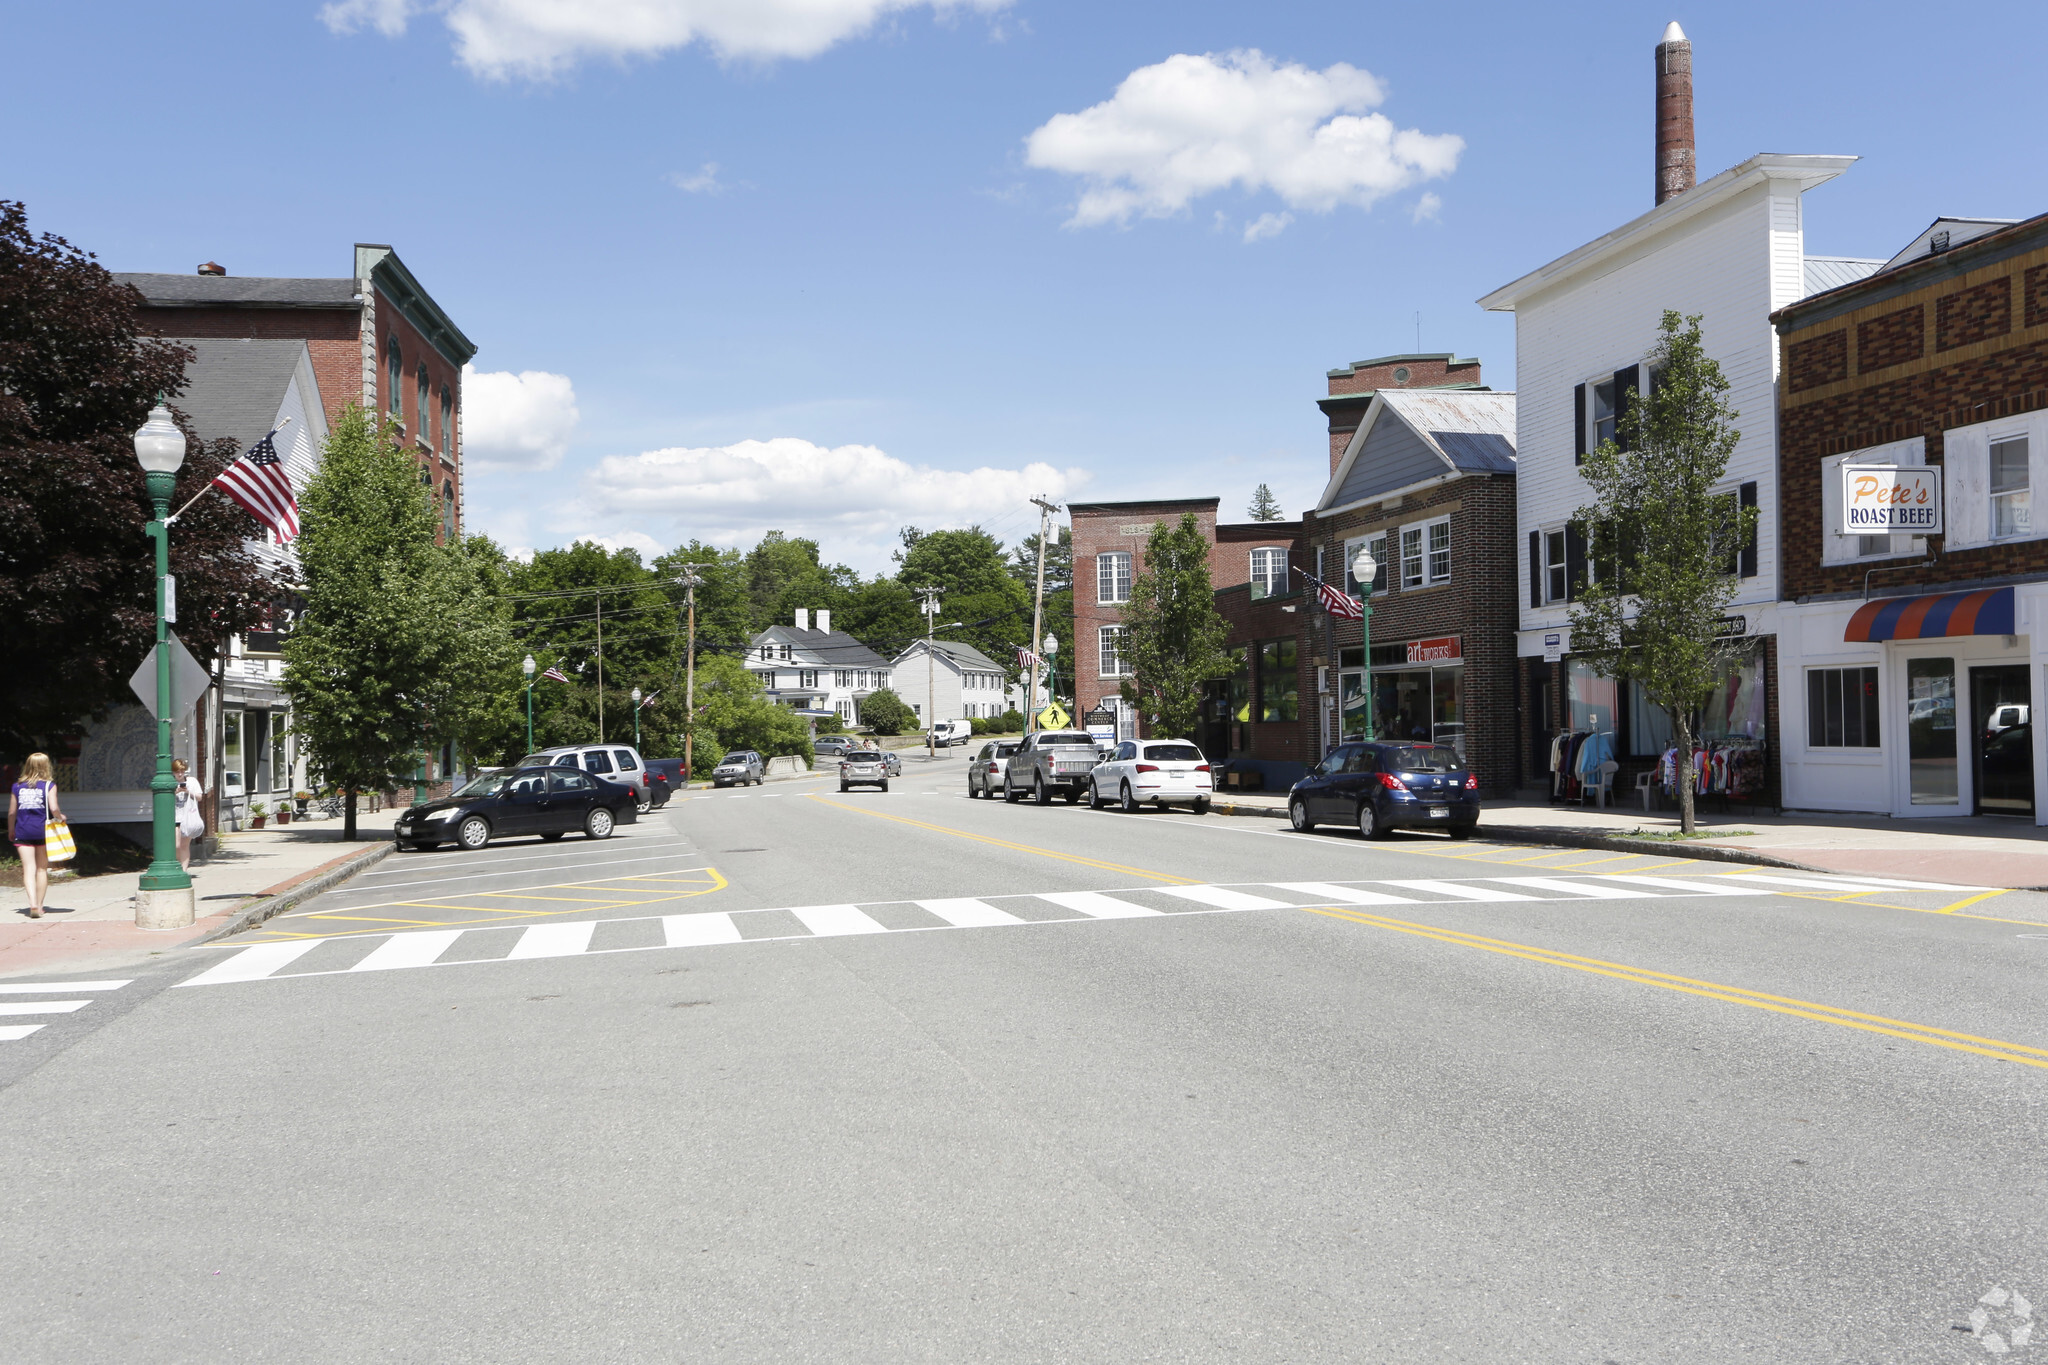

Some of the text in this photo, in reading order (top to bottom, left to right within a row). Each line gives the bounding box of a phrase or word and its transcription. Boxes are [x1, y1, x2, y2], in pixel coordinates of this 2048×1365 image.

[1853, 475, 1930, 505] Pete's
[1850, 508, 1934, 524] ROAST BEEF
